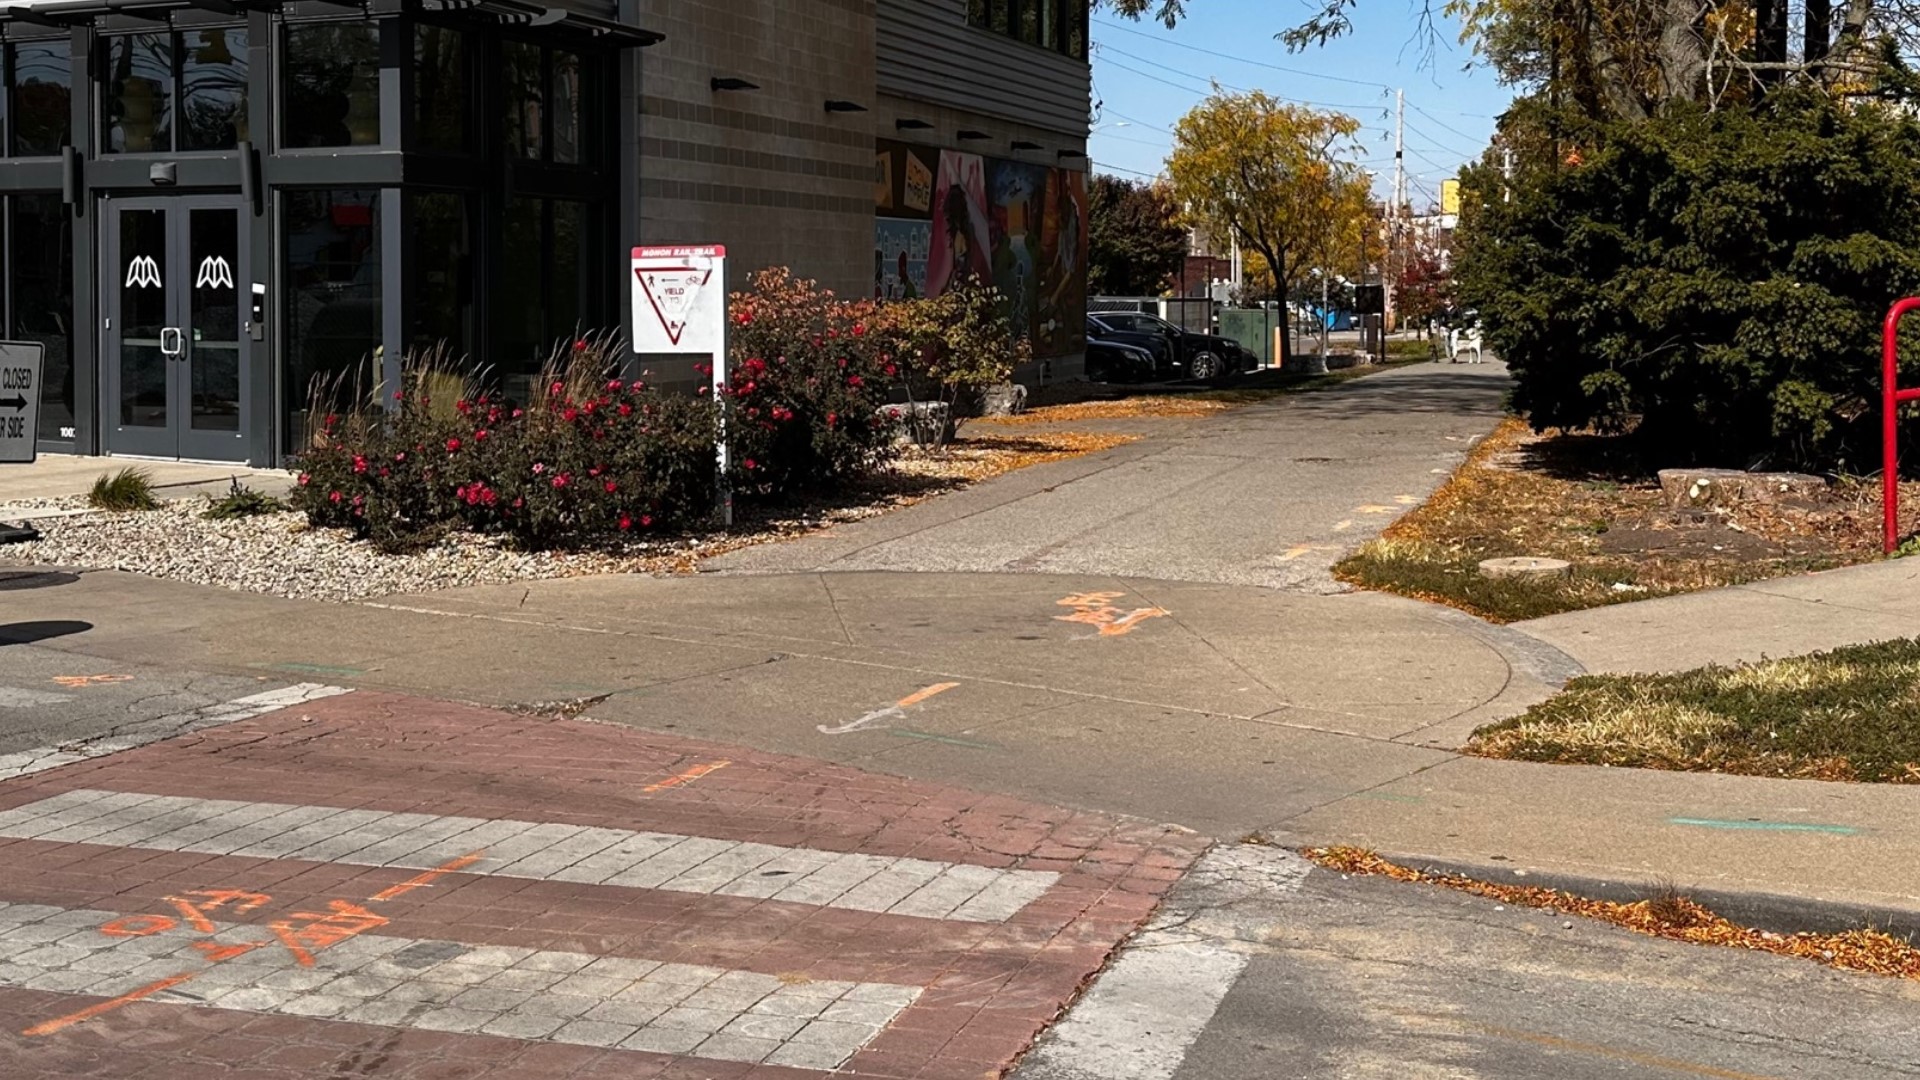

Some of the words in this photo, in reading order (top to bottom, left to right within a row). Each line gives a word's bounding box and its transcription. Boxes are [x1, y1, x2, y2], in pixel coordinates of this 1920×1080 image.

[641, 249, 671, 257] MONON
[673, 248, 691, 256] RAIL
[692, 248, 715, 256] TRAIL
[664, 287, 684, 295] YIELD
[3, 367, 32, 389] CLOSED
[7, 416, 25, 438] SIDE
